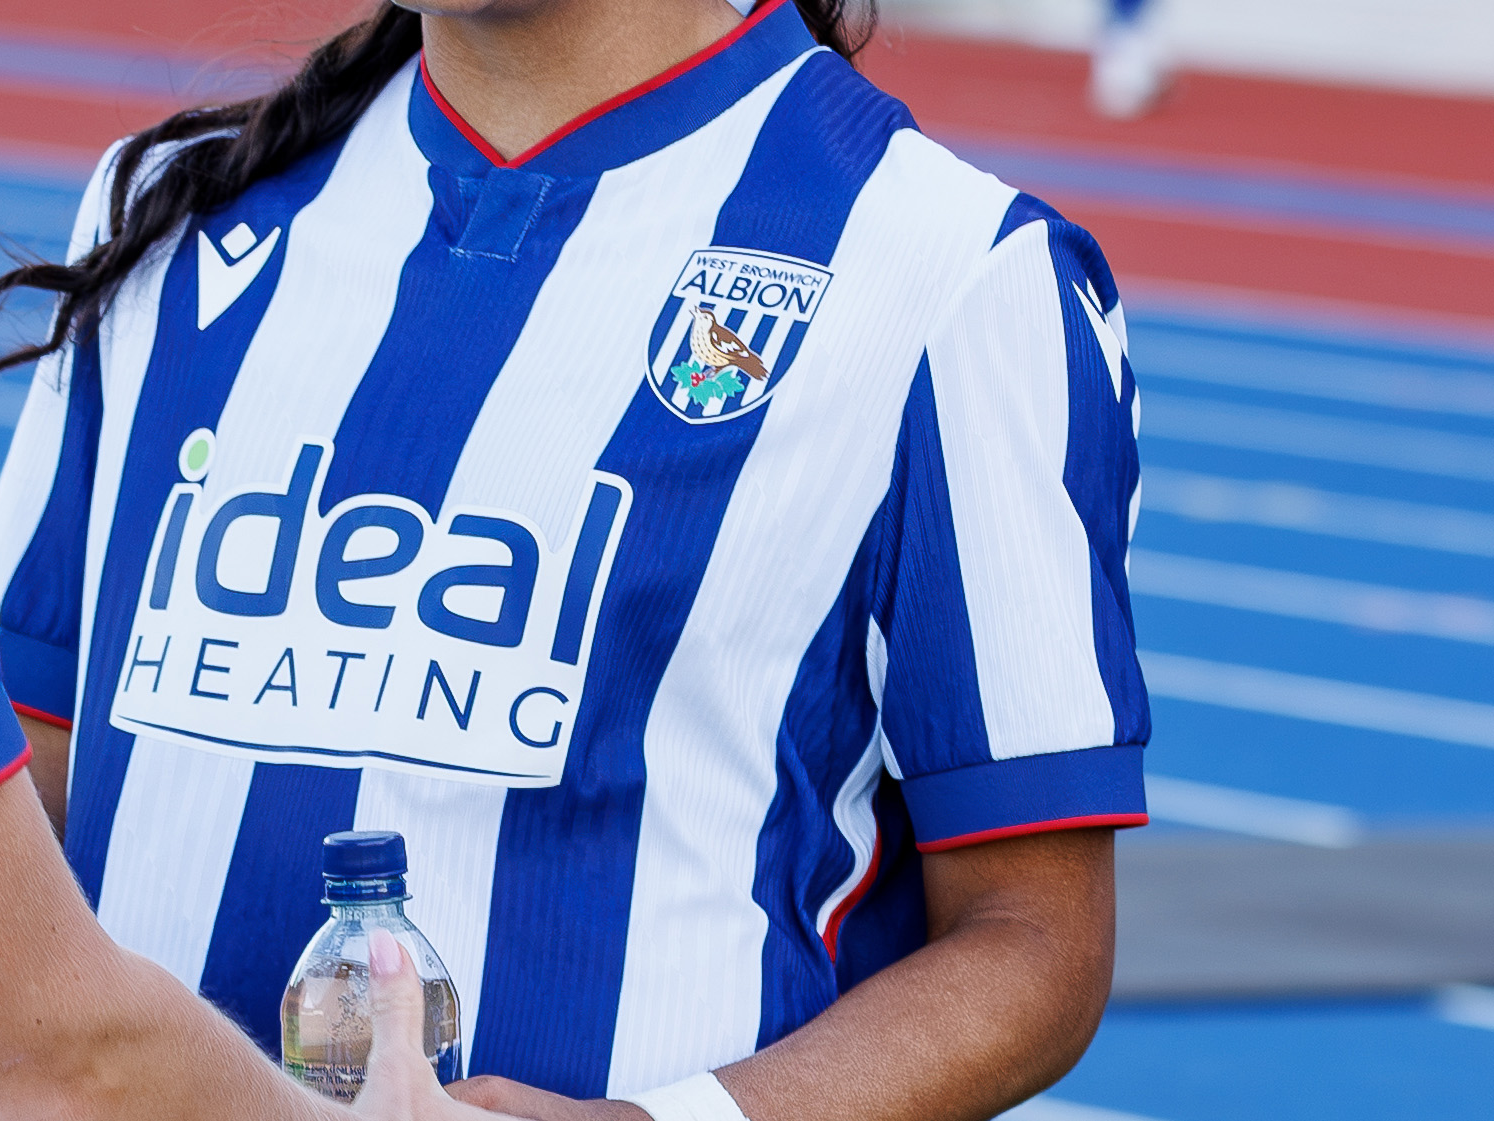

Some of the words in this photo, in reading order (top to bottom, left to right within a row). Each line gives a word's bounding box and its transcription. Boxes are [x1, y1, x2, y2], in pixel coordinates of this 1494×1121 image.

[680, 269, 816, 314] ALBION
[696, 255, 737, 271] WEST
[740, 264, 823, 287] BROMWICH
[149, 438, 623, 666] ideal
[123, 635, 570, 749] HEATING
